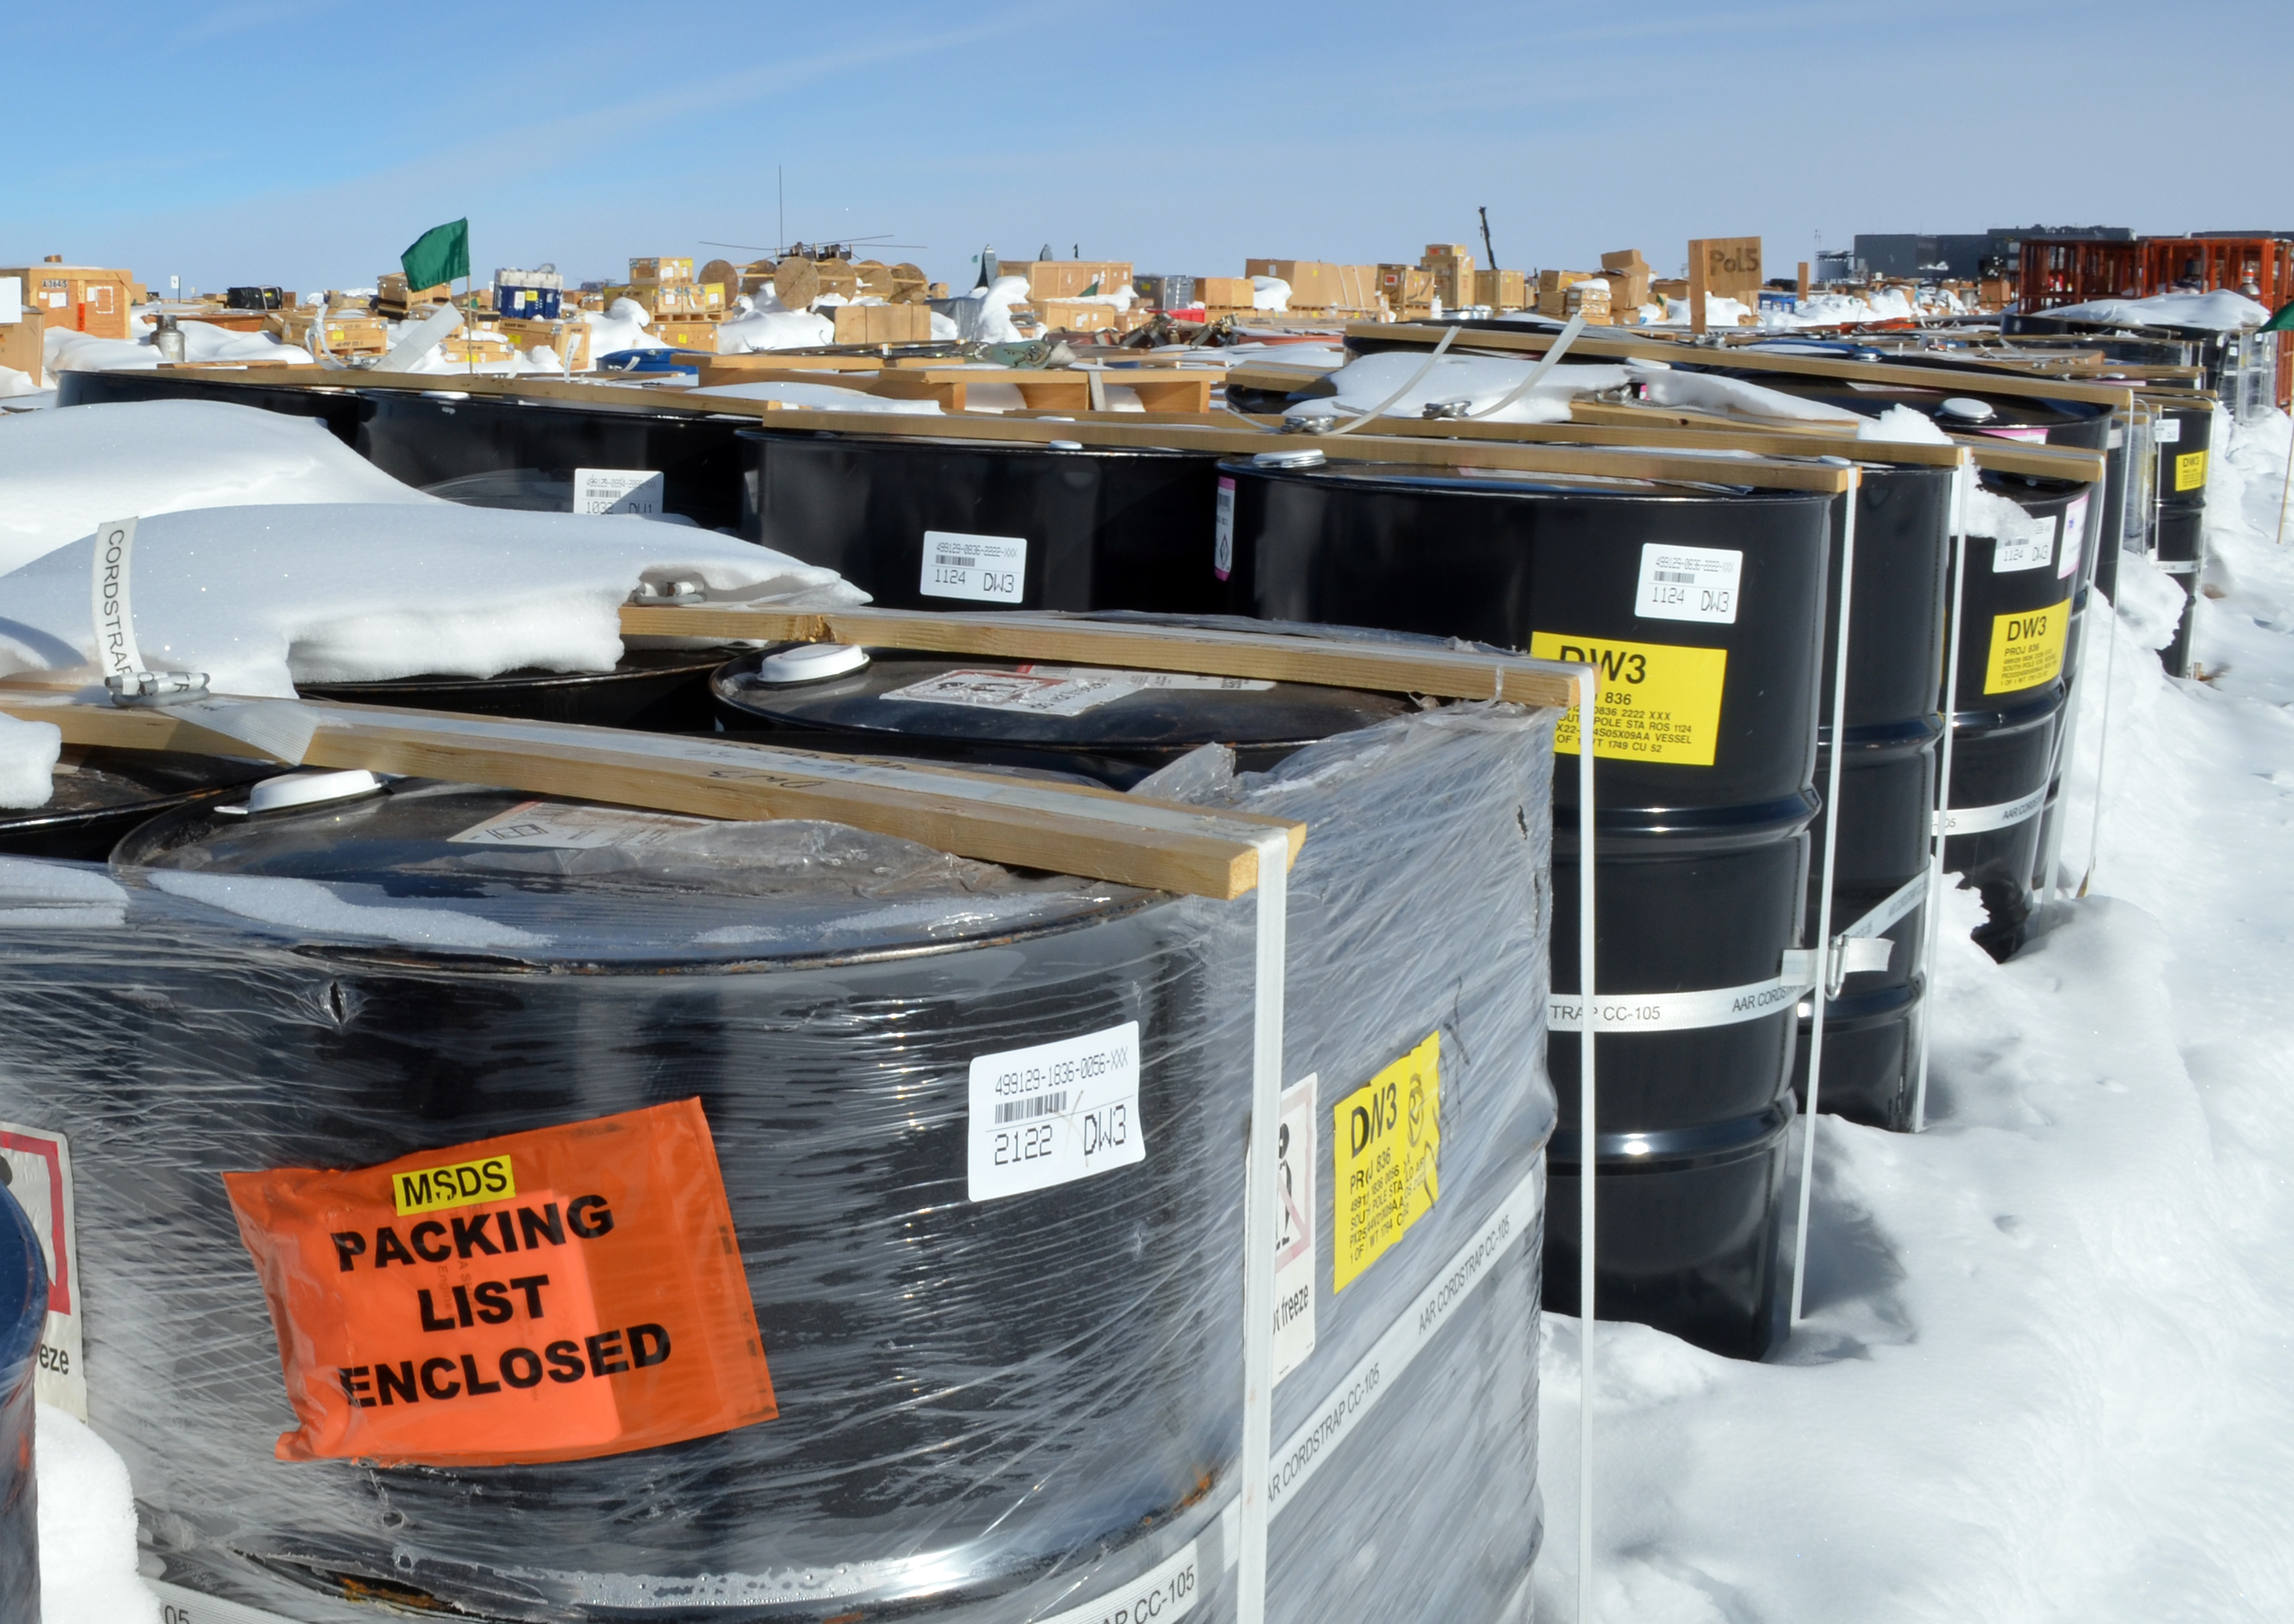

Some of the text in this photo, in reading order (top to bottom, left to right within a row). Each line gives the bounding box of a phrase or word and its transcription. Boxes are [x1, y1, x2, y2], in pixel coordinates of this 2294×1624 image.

[935, 568, 1014, 593] 1124 DW3
[1652, 587, 1729, 613] 1124 DW3
[2007, 616, 2047, 642] DW3
[2004, 646, 2025, 657] PROJ
[1605, 692, 1632, 705] 836
[1594, 718, 1621, 728] POLE
[1626, 721, 1645, 730] STA
[1649, 723, 1670, 732] ROS
[1674, 724, 1692, 733] 1124
[1622, 709, 1645, 718] 2222
[1649, 712, 1671, 721] XXX
[1556, 735, 1573, 744] OF
[1608, 740, 1628, 750] 1749
[1633, 743, 1647, 752] CU
[1651, 745, 1661, 753] 52
[1655, 733, 1692, 745] VESSEL
[1603, 1006, 1661, 1021] CC-105
[1732, 996, 1755, 1013] AAR
[995, 1045, 1128, 1097] 499129-1836-0056-XXX
[994, 1104, 1127, 1166] 2122 DW3
[1377, 1147, 1391, 1173] 836
[401, 1160, 508, 1207] MSDS
[1389, 1180, 1403, 1198] STA
[329, 1194, 614, 1273] PACKING
[1418, 1214, 1511, 1336] AAR CORDSTRAP CC-105
[417, 1274, 550, 1333] LIST
[1281, 1283, 1310, 1327] freeze
[338, 1322, 672, 1408] ENCLOSED
[1282, 1400, 1346, 1487] CORDSTRAP
[1347, 1361, 1381, 1415] CC-105
[1134, 1564, 1195, 1624] CC-105
